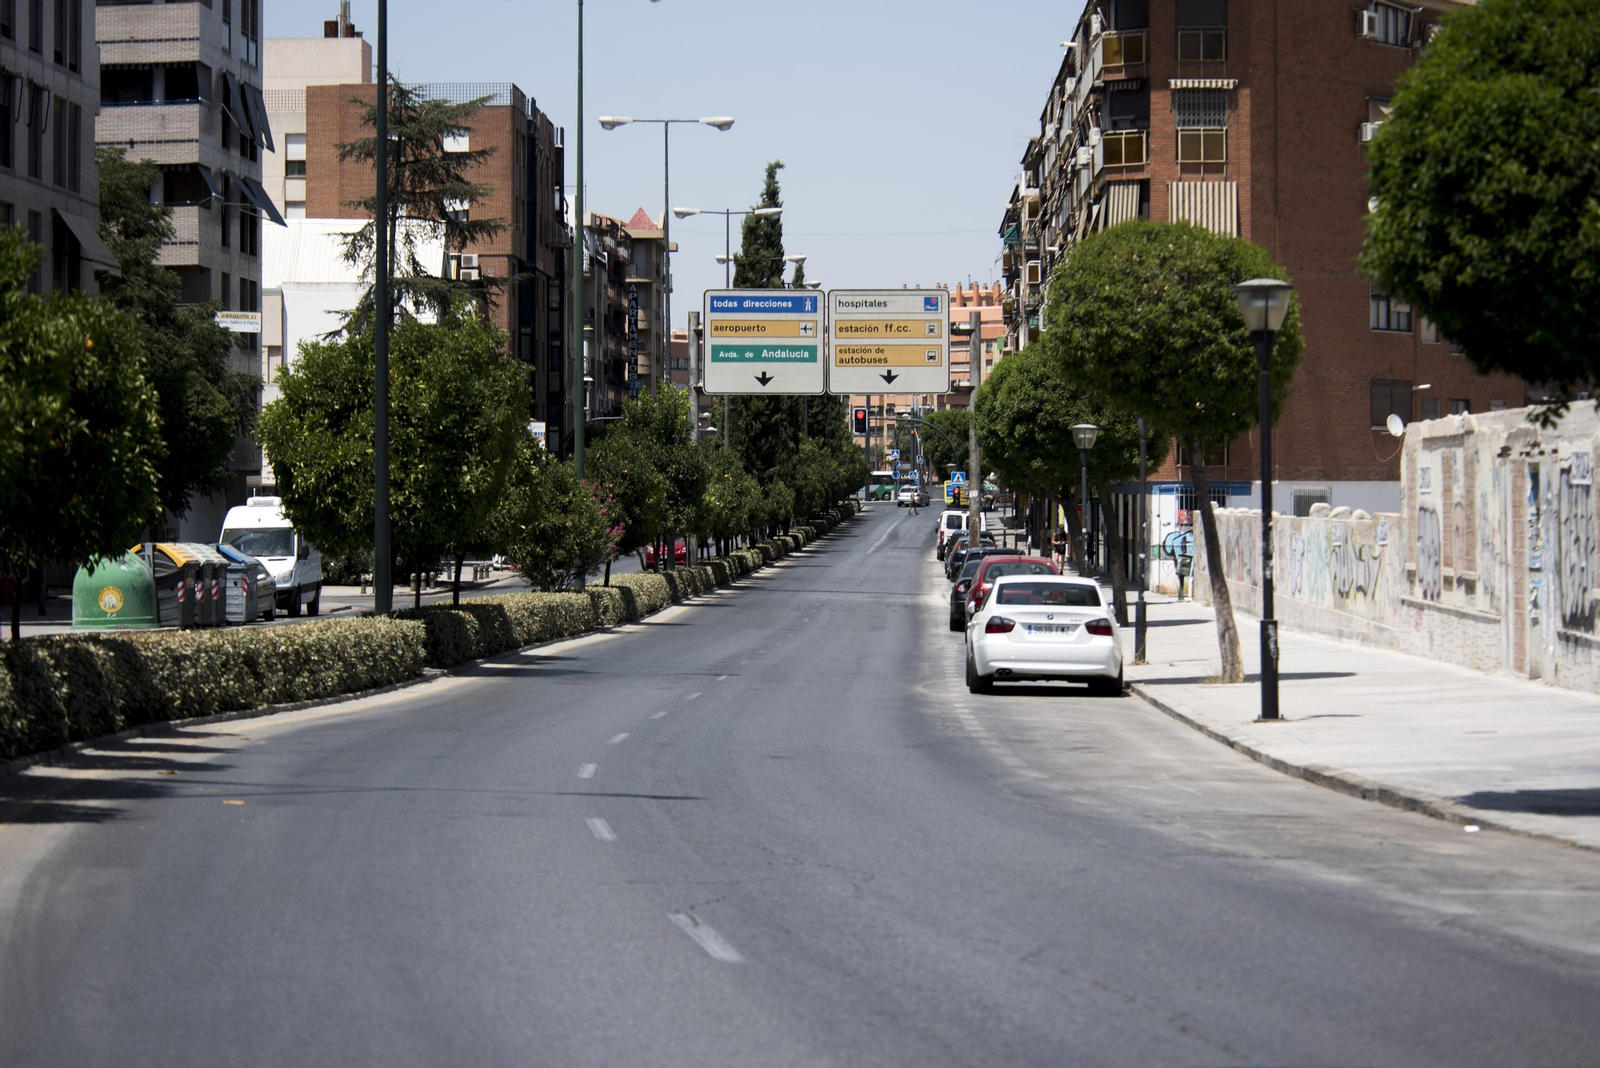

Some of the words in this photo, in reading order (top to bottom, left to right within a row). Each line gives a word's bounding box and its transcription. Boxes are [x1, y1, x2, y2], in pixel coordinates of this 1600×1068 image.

[713, 300, 738, 308] todas
[743, 300, 793, 308] direcciones
[838, 299, 888, 309] hospitales
[629, 283, 638, 380] APARTAMENTOS
[713, 324, 767, 333] aeropuerto
[838, 324, 879, 333] estación
[884, 323, 912, 333] ff.cc.
[761, 349, 810, 358] Andalucía
[838, 356, 889, 364] autobuses
